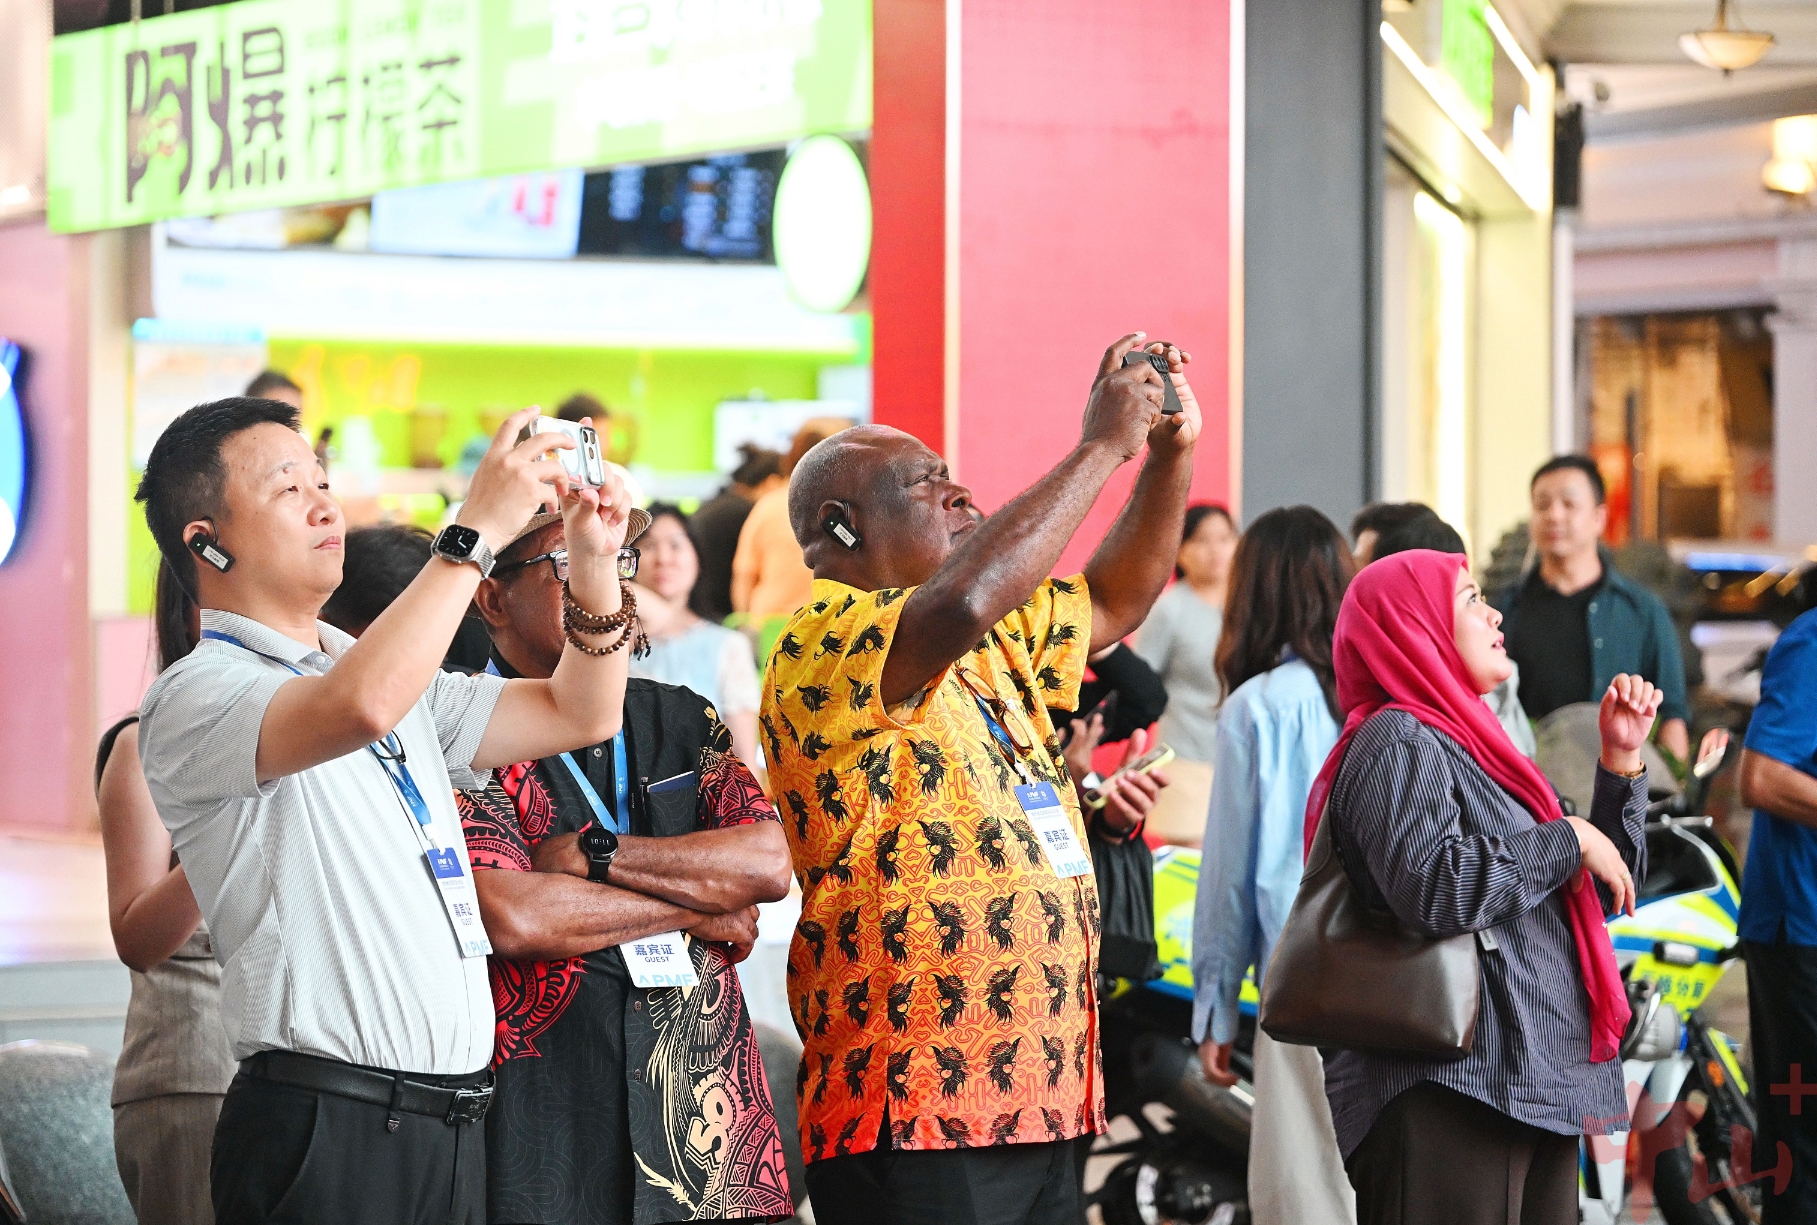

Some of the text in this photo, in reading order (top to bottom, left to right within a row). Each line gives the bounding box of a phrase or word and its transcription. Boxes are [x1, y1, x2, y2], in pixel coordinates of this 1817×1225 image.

[590, 838, 610, 846] 10:11
[1043, 828, 1070, 843] 嘉宾证
[1053, 842, 1070, 850] GUEST
[1056, 860, 1089, 877] APMF
[464, 940, 490, 956] APMF
[633, 944, 675, 956] 嘉宾证
[638, 973, 693, 987] APMF
